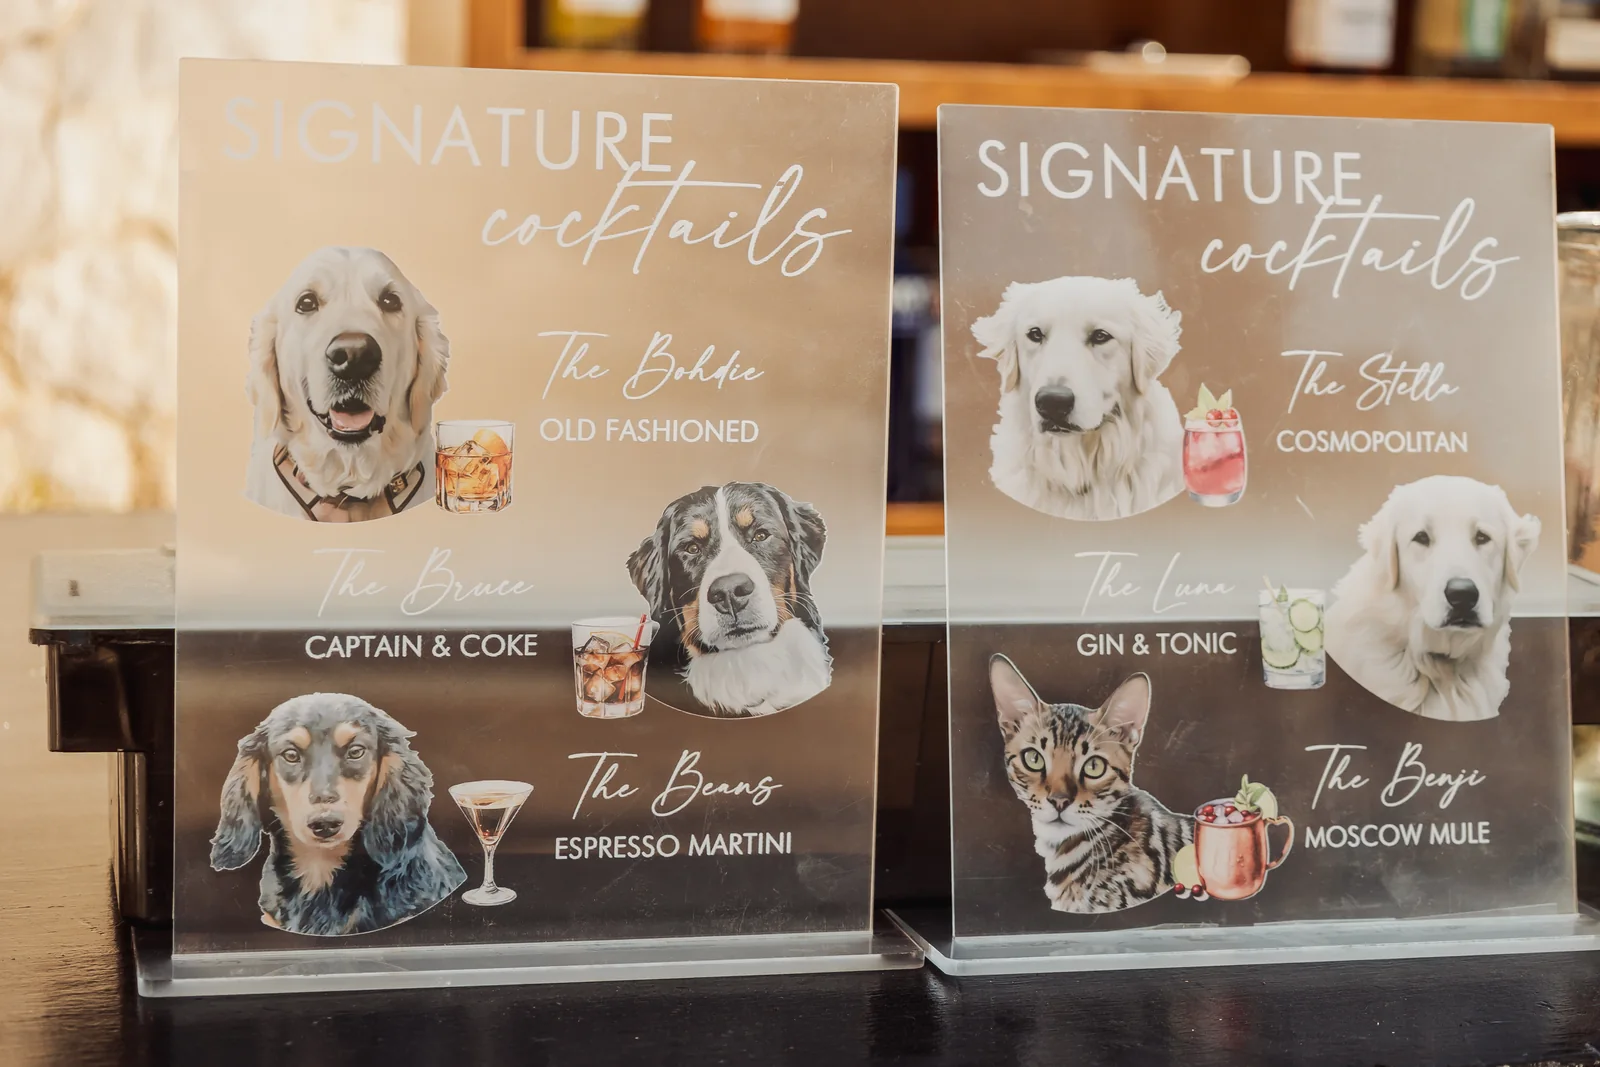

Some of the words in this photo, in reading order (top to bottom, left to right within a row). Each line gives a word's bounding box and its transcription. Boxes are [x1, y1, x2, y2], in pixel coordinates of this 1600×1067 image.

[220, 96, 674, 173] SIGNATURE
[977, 139, 1362, 206] SIGNATURE
[481, 160, 852, 277] cocktails
[1201, 195, 1520, 300] cocktails
[538, 331, 609, 399] The
[623, 331, 765, 400] Bohdie
[1281, 350, 1345, 414] The
[1357, 351, 1459, 411] Stella
[540, 418, 596, 443] OLD
[606, 419, 759, 444] FASHIONED
[1277, 430, 1468, 453] COSMOPOLITAN
[314, 548, 386, 617] The
[401, 547, 534, 616] Bruce
[1075, 551, 1140, 616] The
[1154, 551, 1235, 614] Luna
[305, 635, 422, 660] CAPTAIN
[432, 635, 451, 659] &
[460, 634, 538, 658] COKE
[1077, 633, 1125, 657] GIN
[1132, 633, 1149, 656] &
[1155, 632, 1237, 655] TONIC
[568, 752, 638, 819] The
[652, 750, 782, 817] Beans
[1305, 744, 1369, 810] The
[1381, 742, 1486, 808] Benji
[555, 835, 680, 860] ESPRESSO
[689, 833, 792, 858] MARTINI
[1305, 824, 1422, 849] MOSCOW
[1429, 821, 1491, 845] MULE
